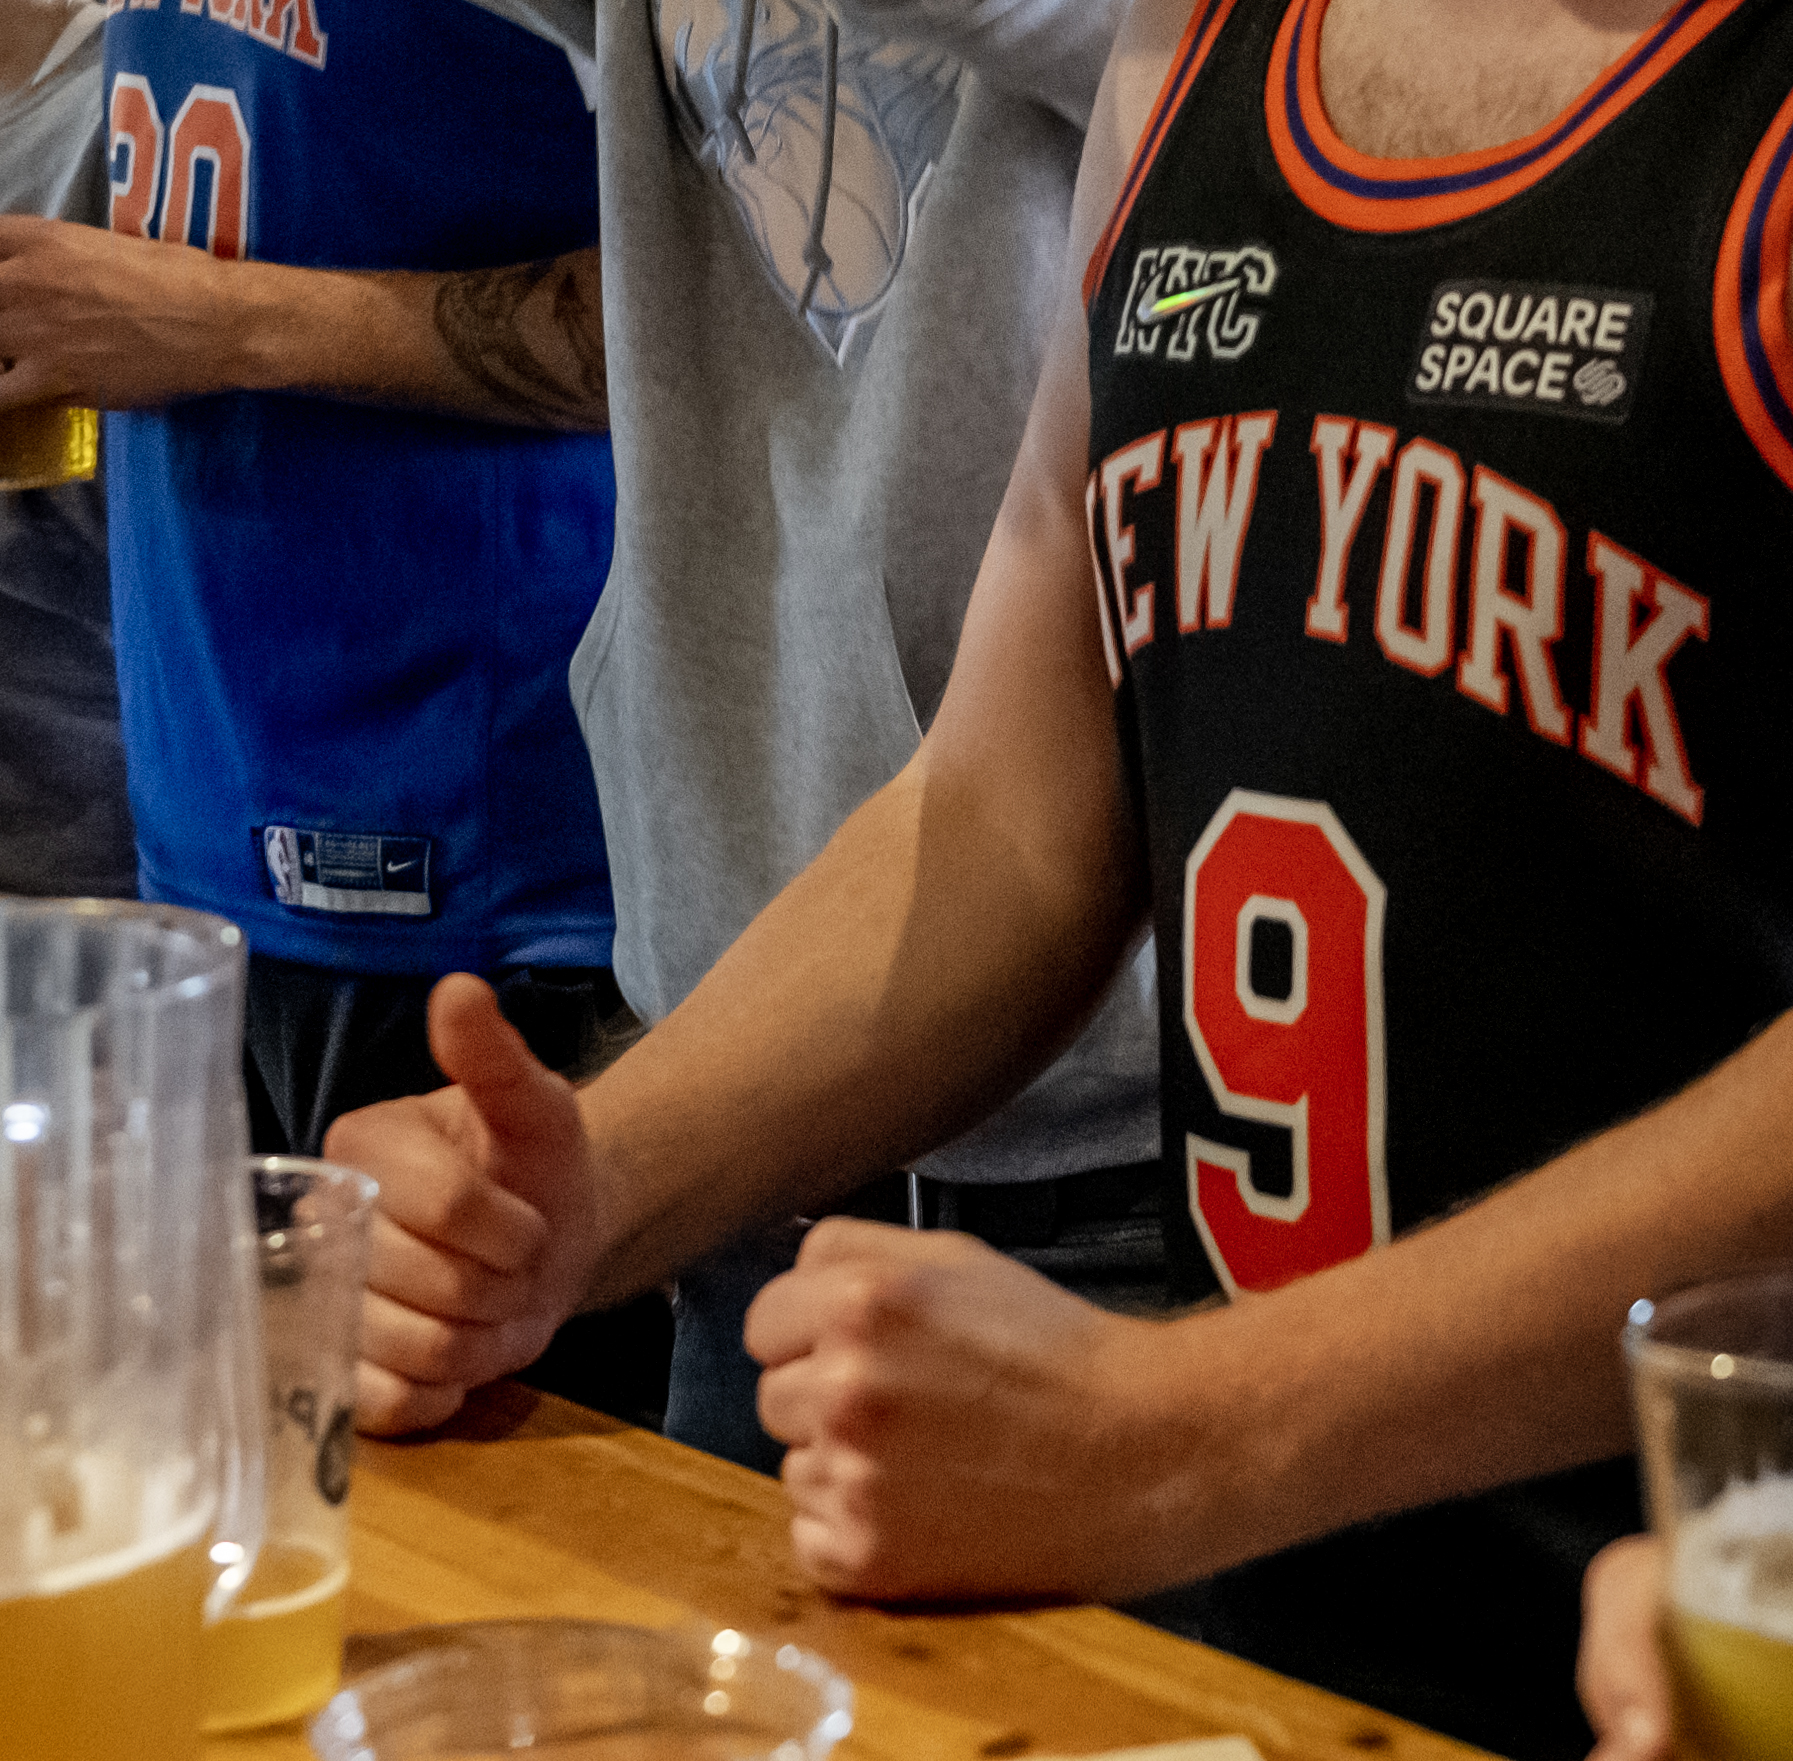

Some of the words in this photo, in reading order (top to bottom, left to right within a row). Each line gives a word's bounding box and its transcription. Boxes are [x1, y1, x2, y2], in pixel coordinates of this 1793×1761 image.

[1415, 343, 1573, 402] SPACE
[1430, 288, 1633, 353] SQUARE
[1305, 412, 1711, 828] YORK
[1182, 786, 1392, 1305] 9
